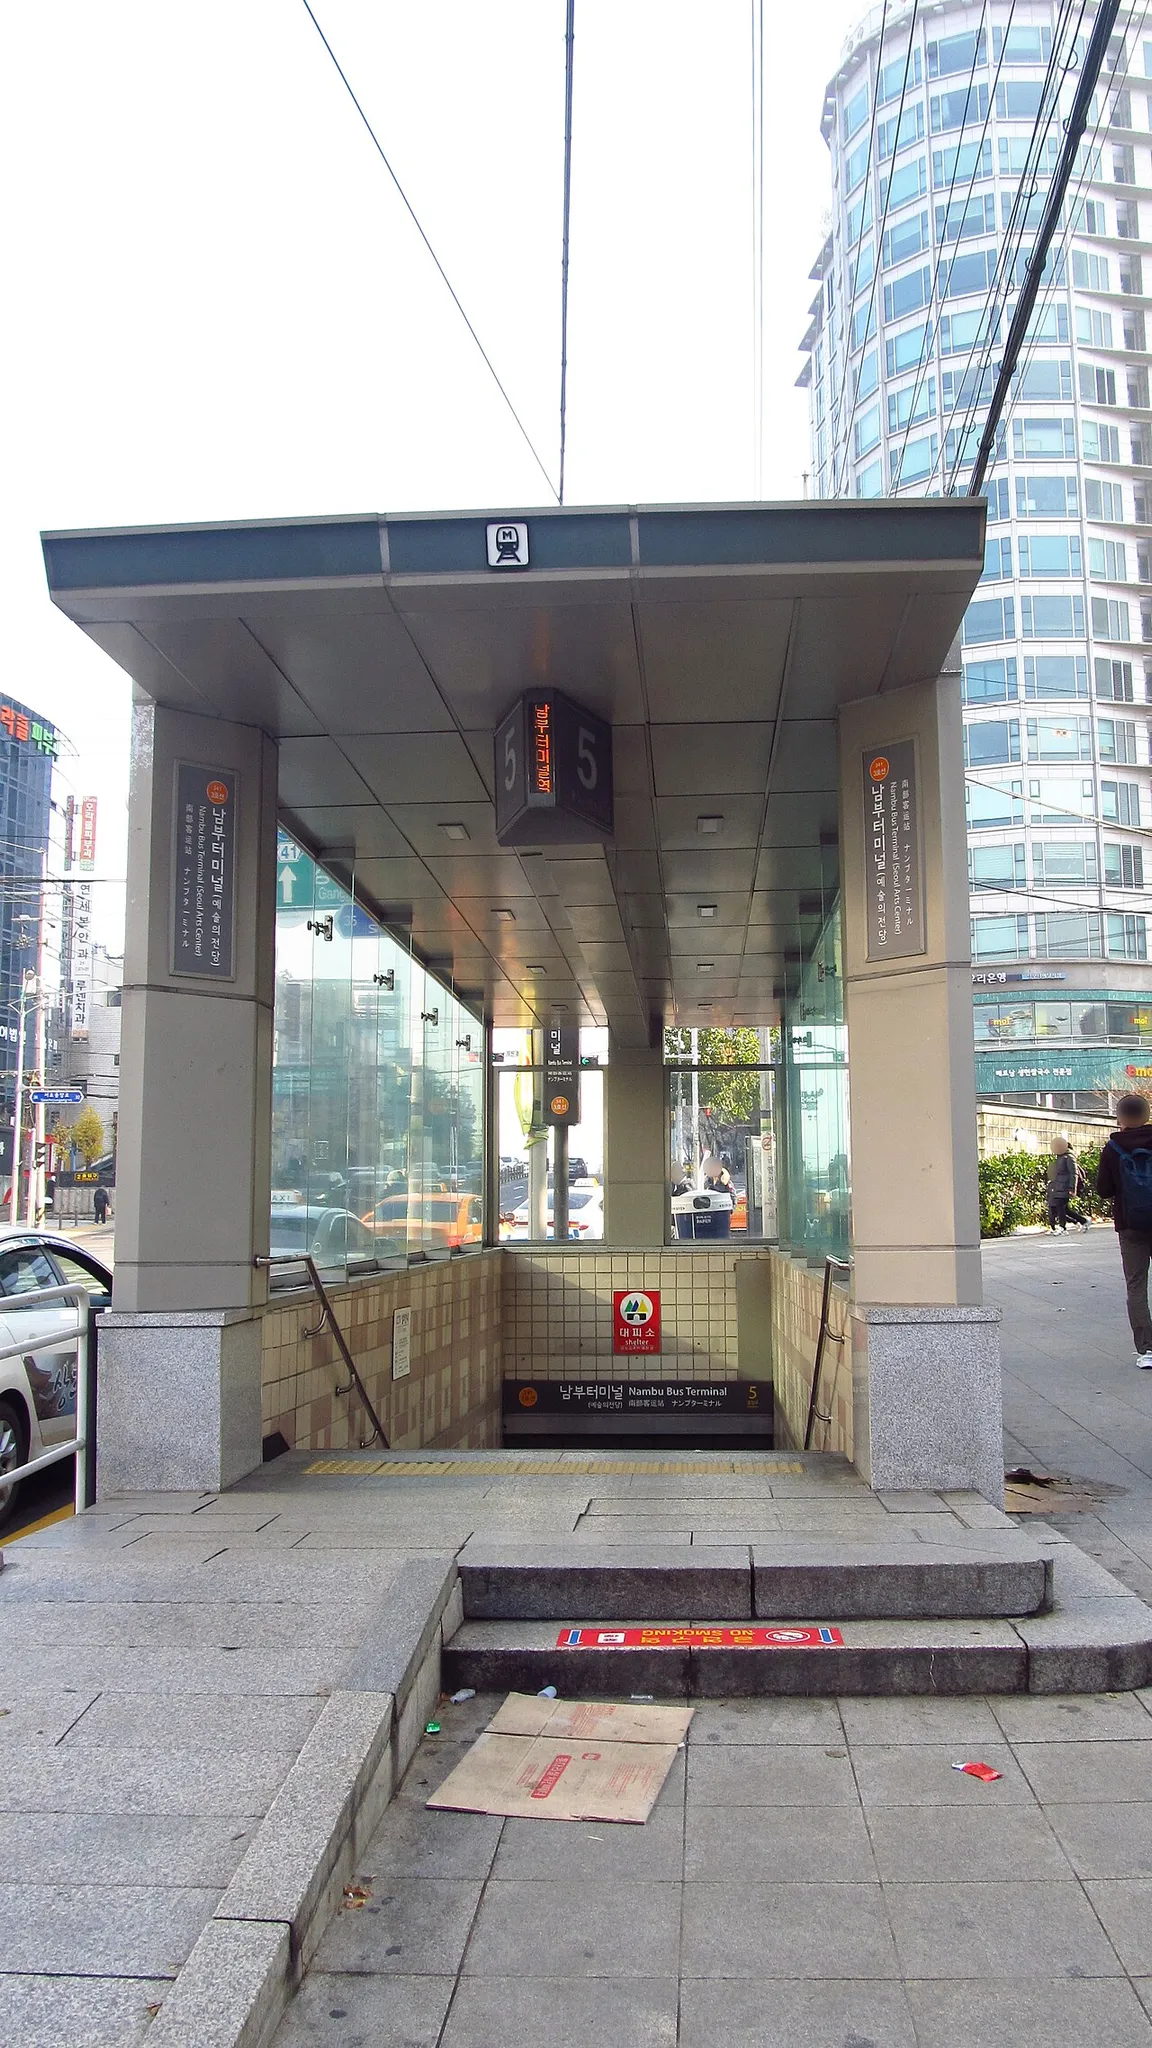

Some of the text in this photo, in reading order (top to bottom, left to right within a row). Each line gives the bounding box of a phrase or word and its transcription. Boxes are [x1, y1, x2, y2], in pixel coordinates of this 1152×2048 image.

[505, 726, 517, 791] 5
[576, 726, 598, 790] 5
[281, 845, 297, 860] 41
[890, 781, 902, 935] Nambu Bus Terminal (Seoul Arts Center)
[194, 805, 207, 957] Nambu Bus Terminal (Seoul Arts Center)
[625, 1338, 649, 1346] shelter
[559, 1384, 623, 1400] 남부터미널
[628, 1386, 727, 1397] Nambu Bus Terminal
[748, 1386, 757, 1399] 5
[671, 1400, 722, 1408] ナンブターミナル
